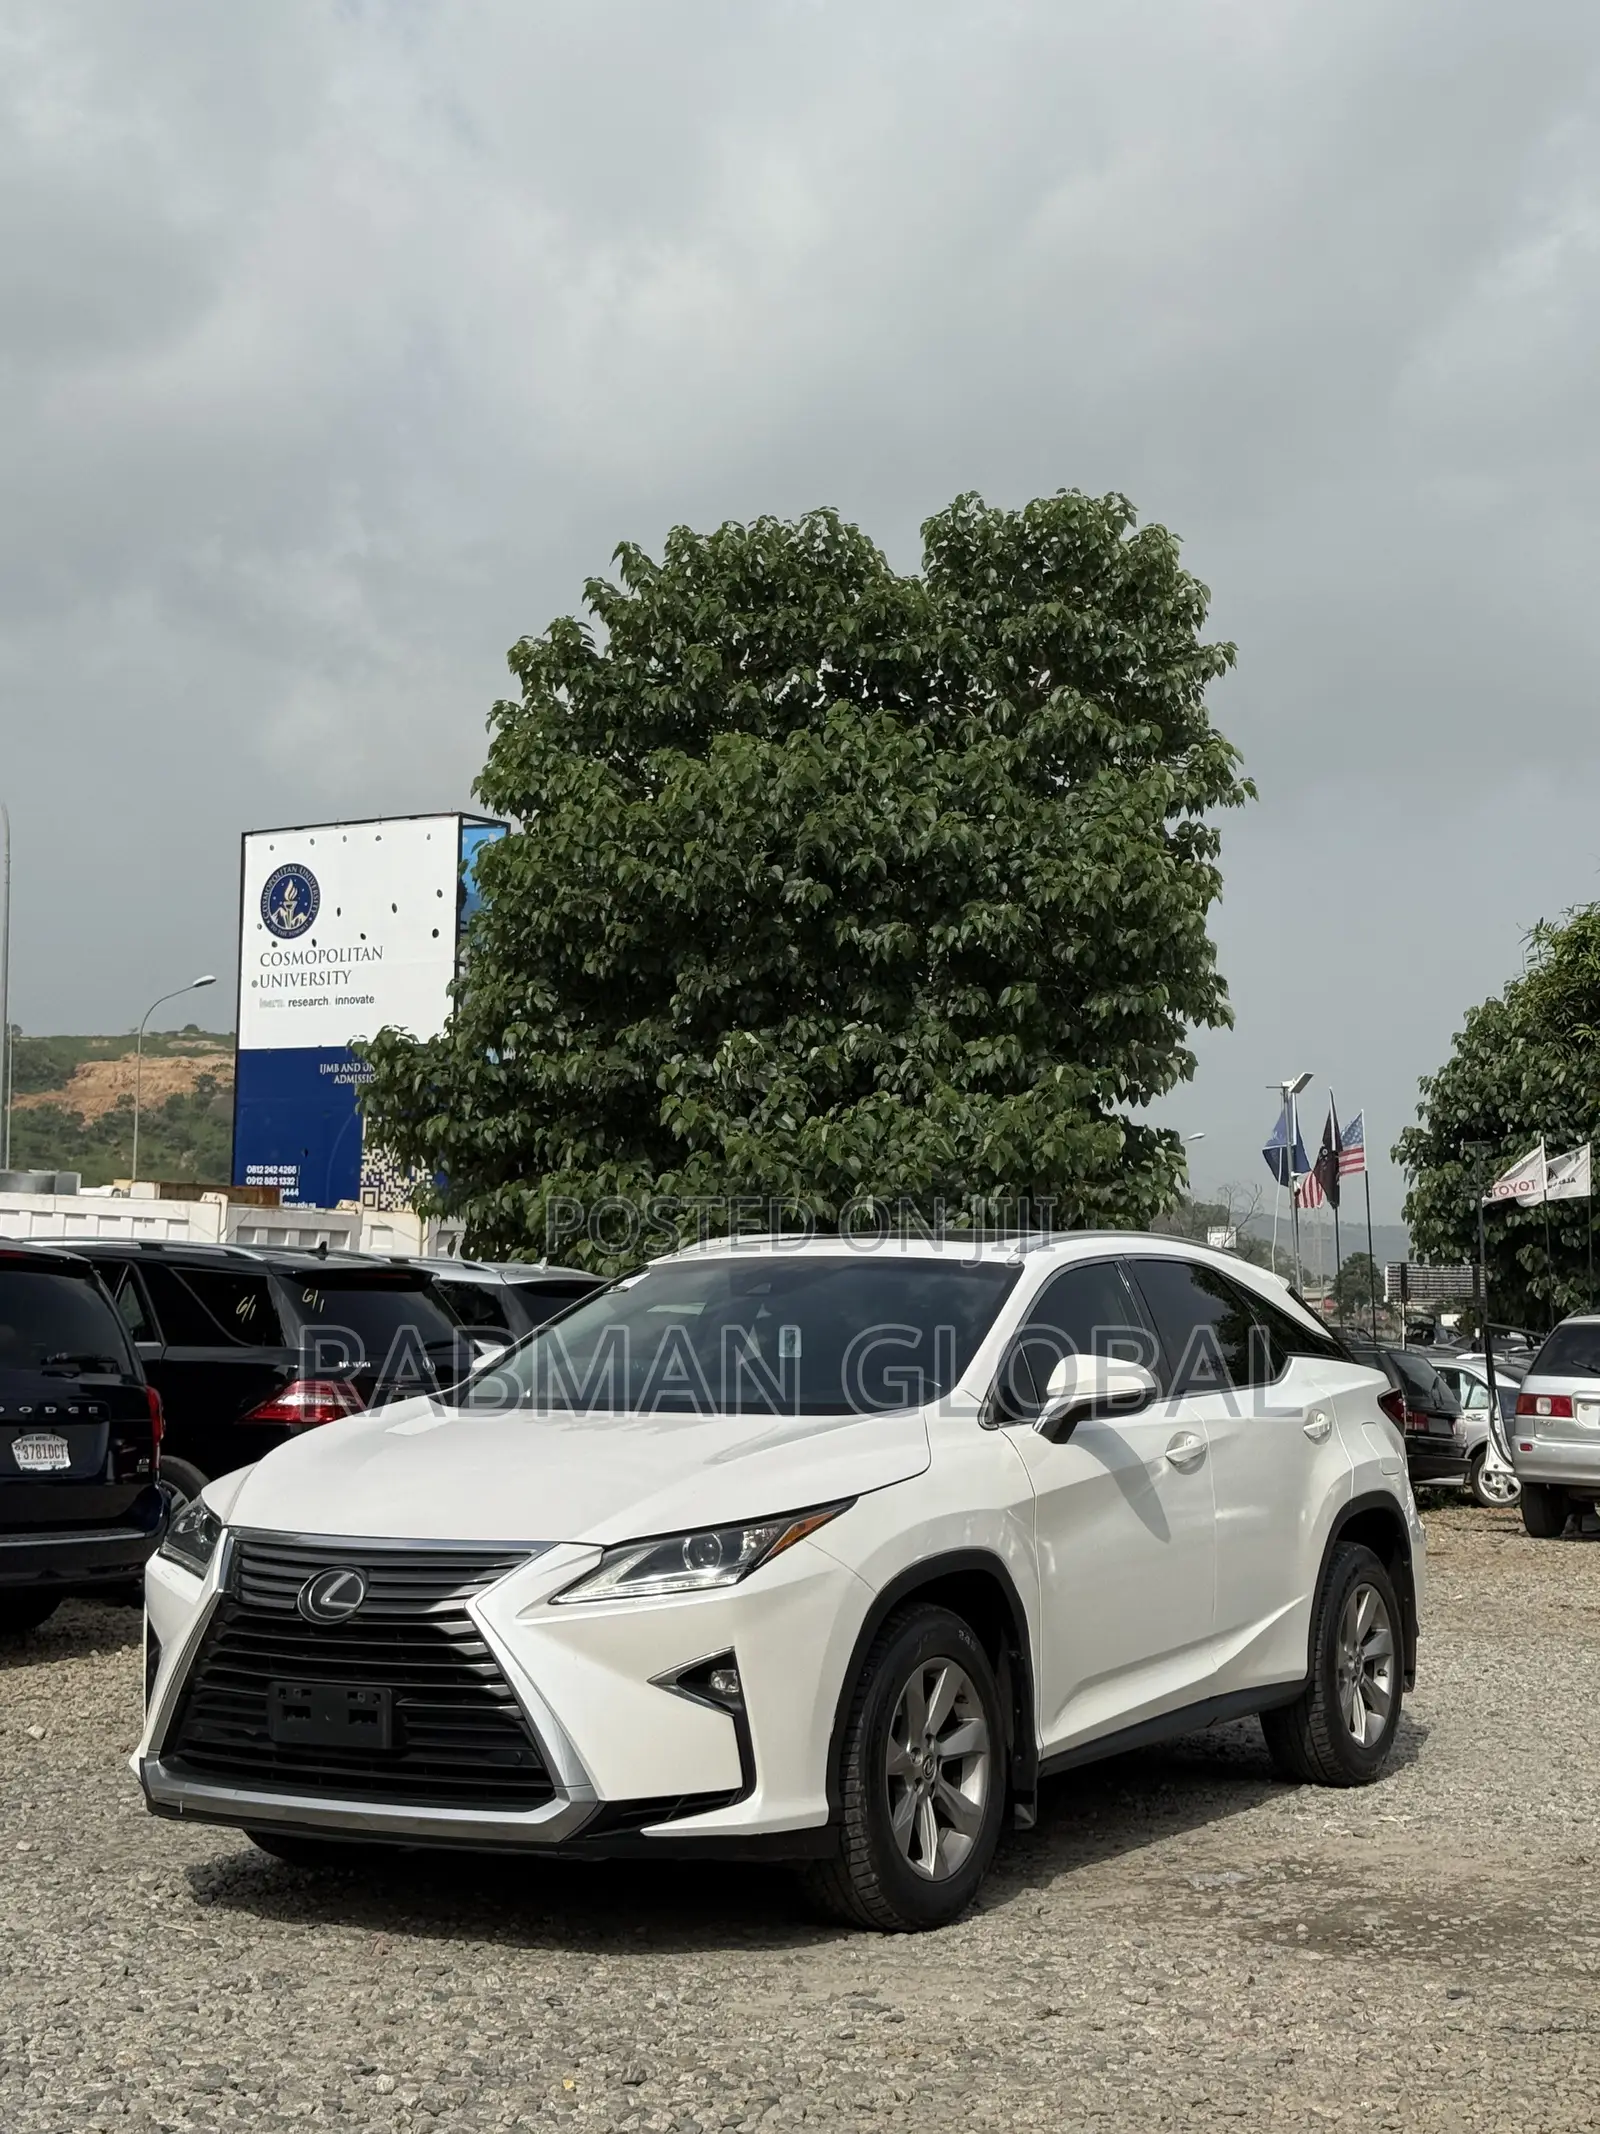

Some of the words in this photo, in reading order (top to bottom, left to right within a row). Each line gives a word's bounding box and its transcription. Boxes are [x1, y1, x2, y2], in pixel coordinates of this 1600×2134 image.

[262, 866, 298, 920] COSMOPOLITAN
[260, 945, 384, 967] COSMOPOLITAN
[260, 969, 352, 988] UNIVERSITY
[320, 1063, 340, 1075] IJMB
[340, 1062, 361, 1073] AND
[246, 1164, 264, 1175] 0812
[264, 1165, 278, 1175] 242
[246, 1176, 263, 1186] 0912
[279, 1176, 296, 1186] 1332
